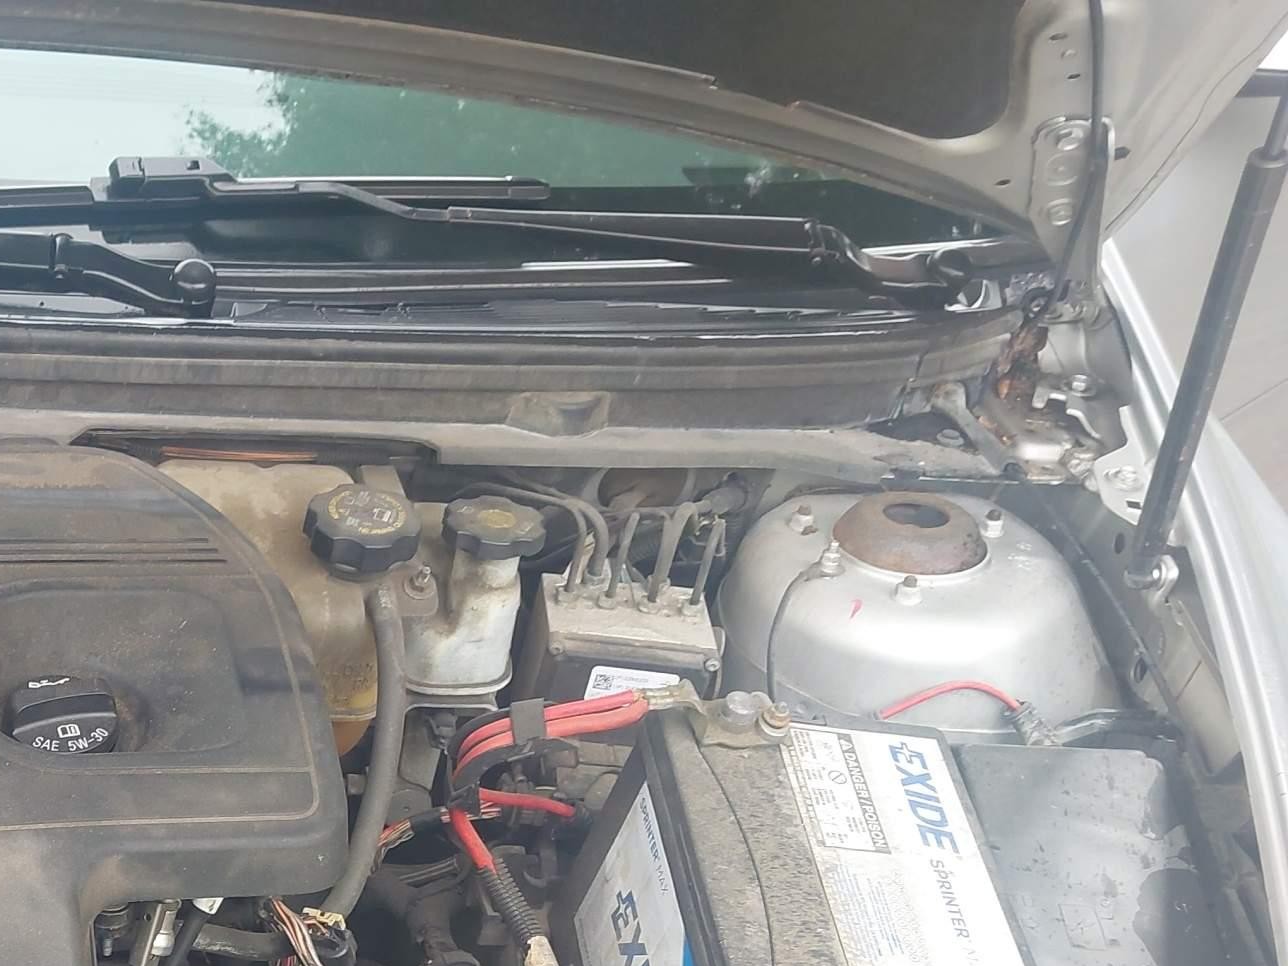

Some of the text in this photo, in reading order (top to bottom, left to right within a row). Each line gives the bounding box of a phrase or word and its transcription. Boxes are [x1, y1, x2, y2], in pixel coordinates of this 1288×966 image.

[32, 728, 109, 752] SAE 5W-30
[639, 797, 660, 862] SPRINTER
[844, 750, 888, 849] DANGER/POISON
[888, 741, 961, 855] EXIDE
[930, 858, 970, 939] SPRINTER
